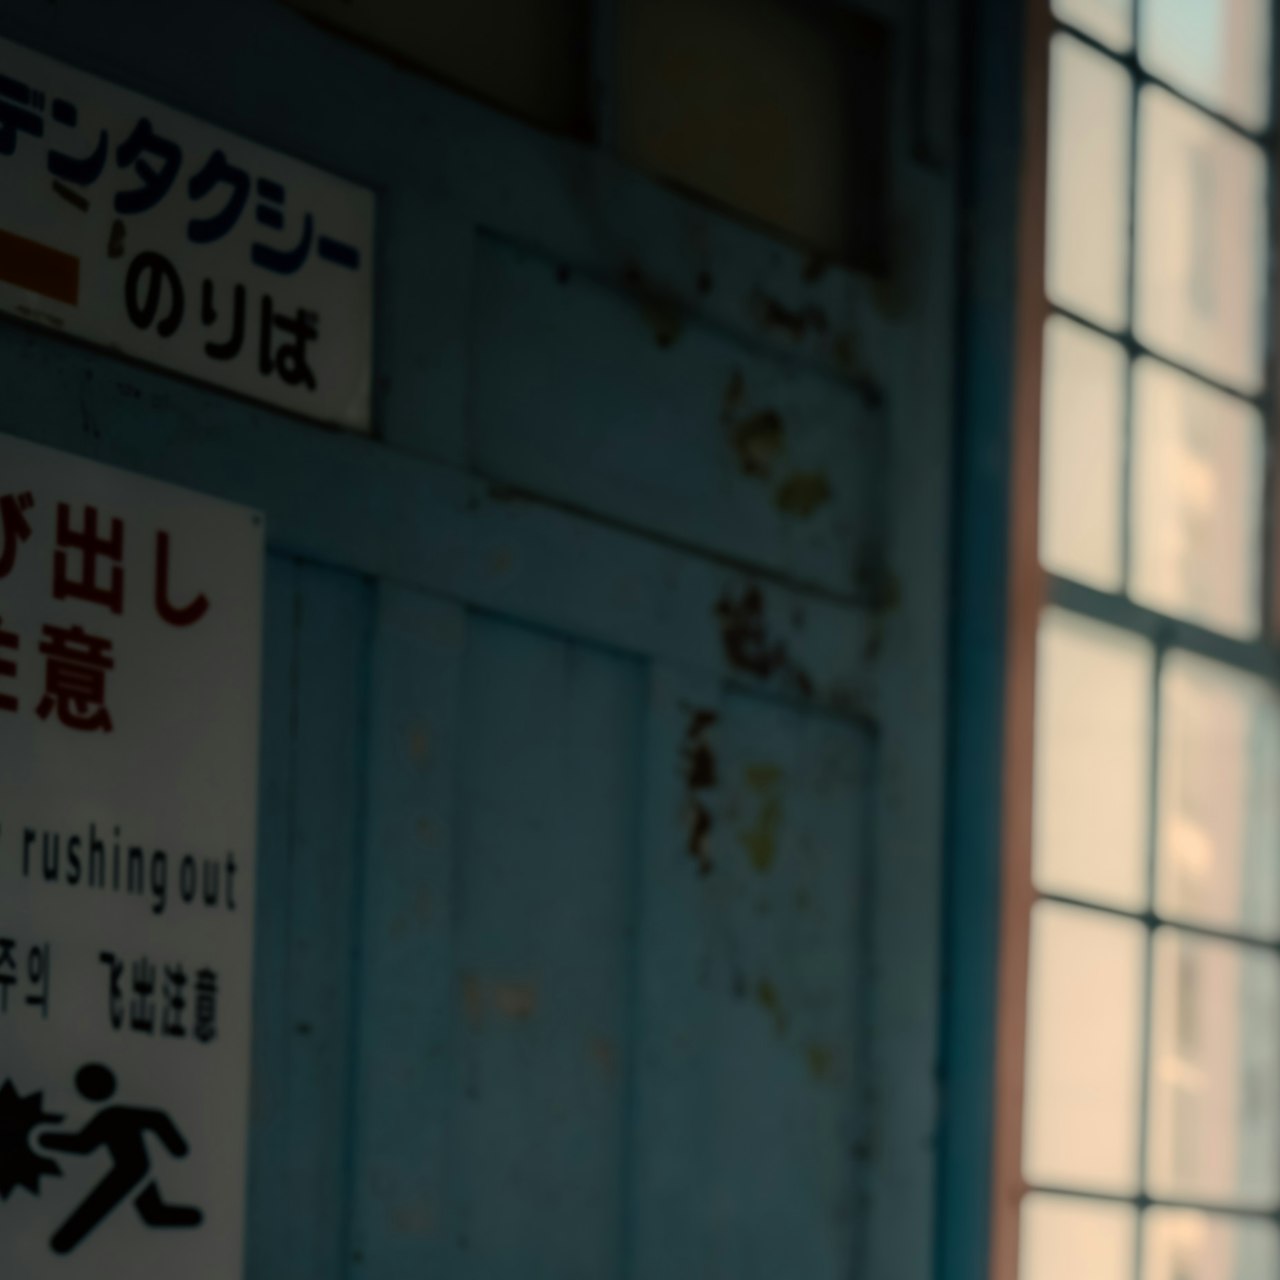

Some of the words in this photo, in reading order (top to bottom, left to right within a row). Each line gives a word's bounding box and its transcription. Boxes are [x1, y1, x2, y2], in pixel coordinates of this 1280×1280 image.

[125, 252, 318, 391] のりば
[99, 951, 217, 1042] 飞出注意
